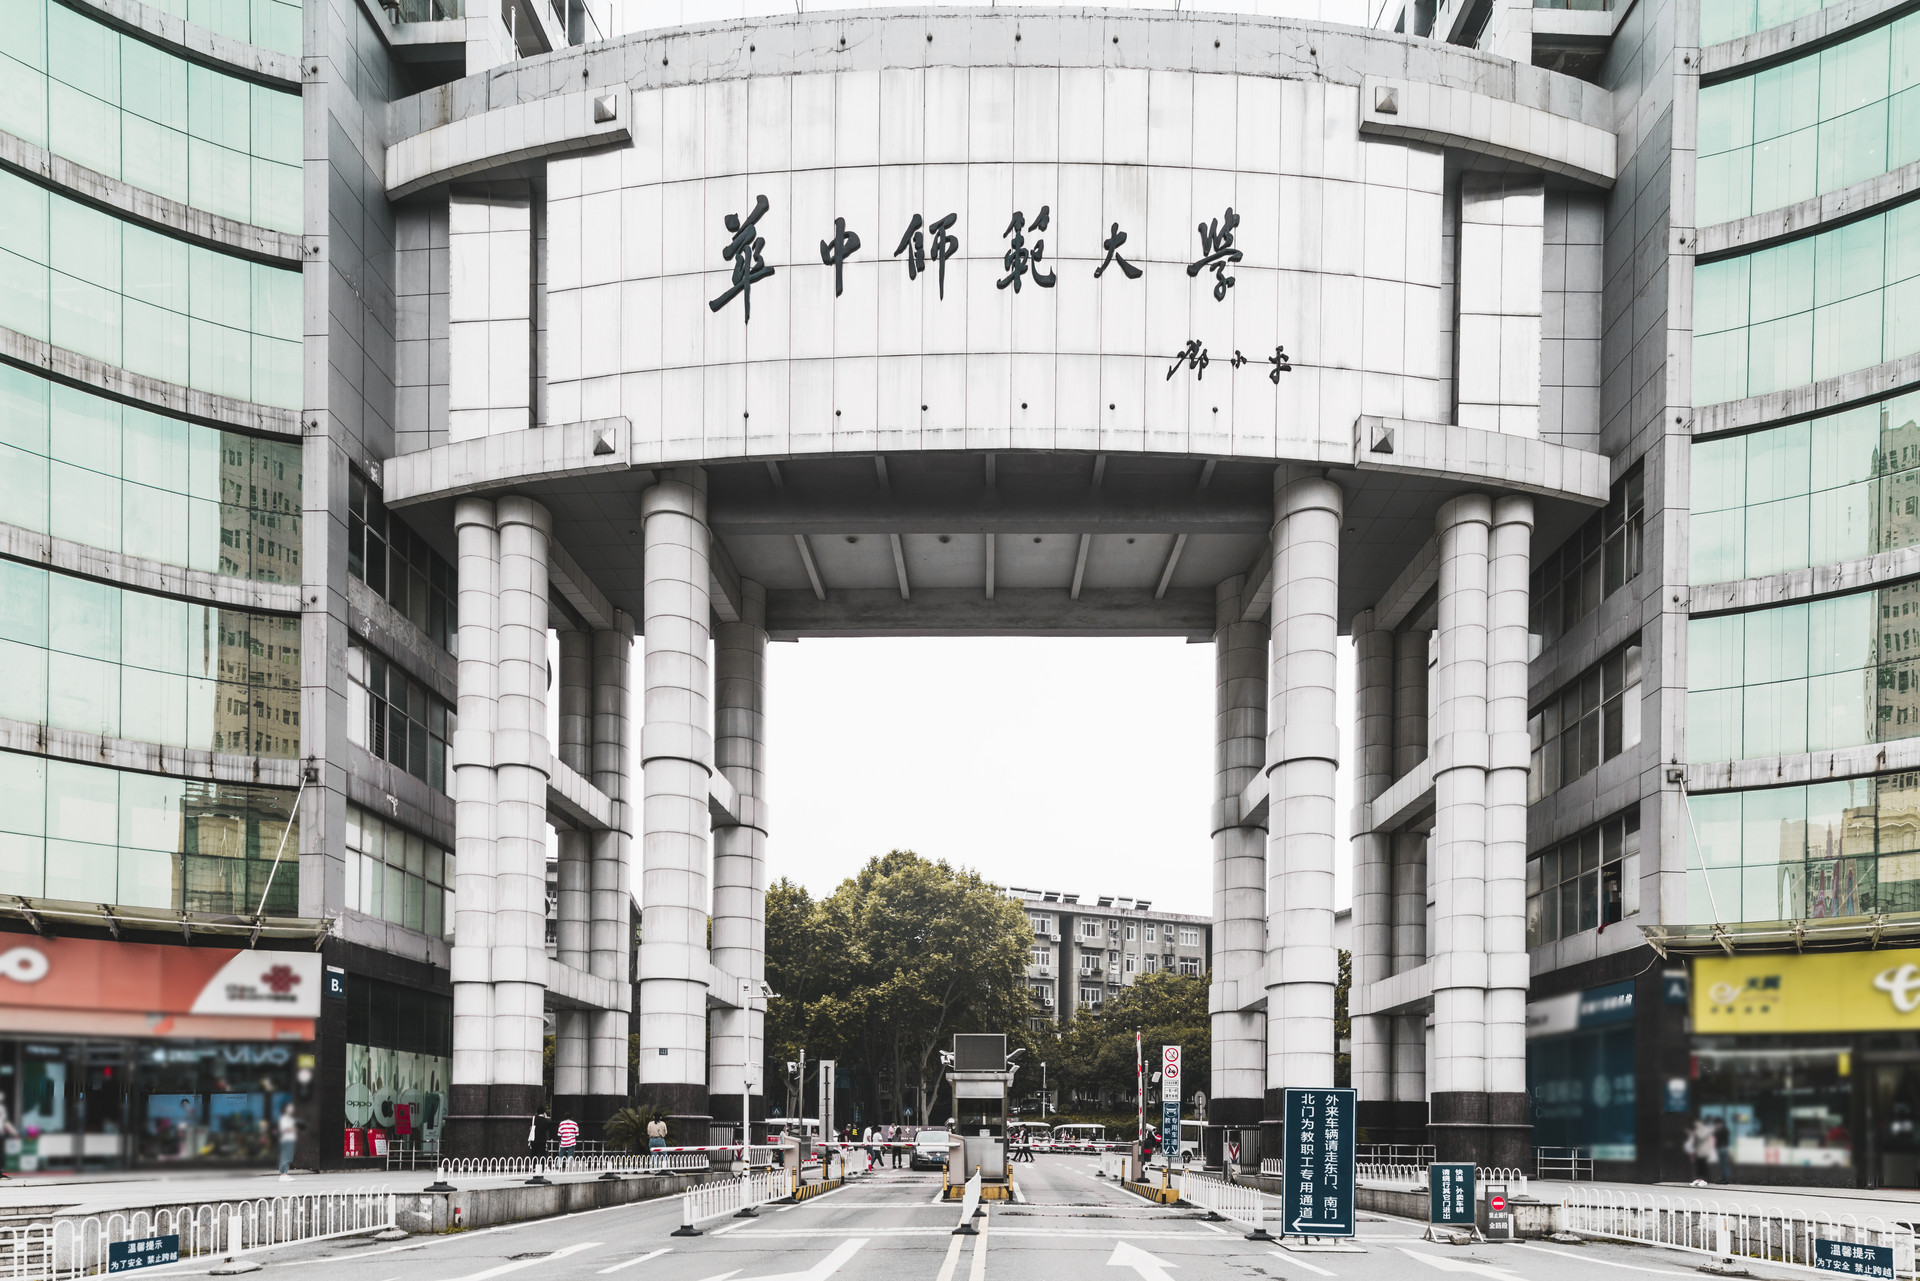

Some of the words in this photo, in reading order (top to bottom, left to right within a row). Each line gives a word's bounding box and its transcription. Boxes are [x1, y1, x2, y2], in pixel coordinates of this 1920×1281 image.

[1299, 1093, 1315, 1219] 北门为教职工专用通道
[127, 1239, 163, 1254] 温馨提示
[1830, 1243, 1876, 1260] 温馨提示
[110, 1257, 143, 1270] 为了安全
[1816, 1257, 1850, 1271] 为了安全
[1854, 1263, 1893, 1278] 禁止跨越
